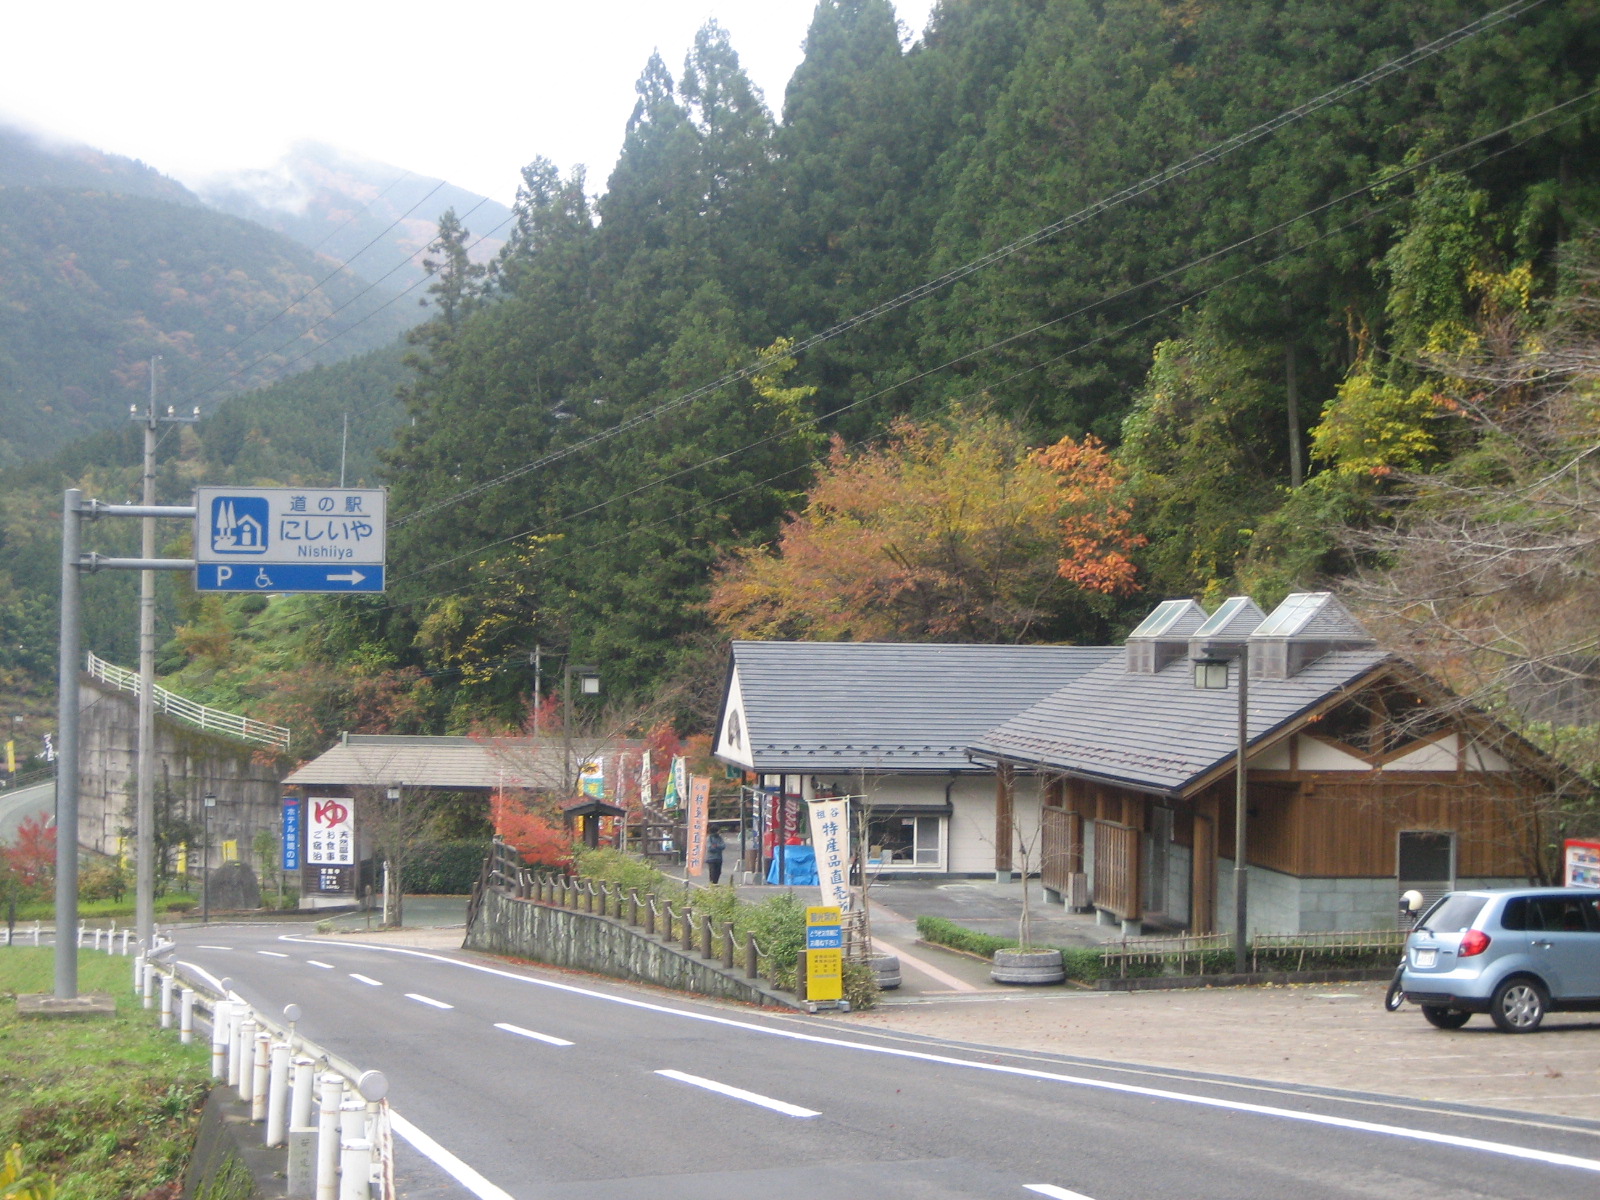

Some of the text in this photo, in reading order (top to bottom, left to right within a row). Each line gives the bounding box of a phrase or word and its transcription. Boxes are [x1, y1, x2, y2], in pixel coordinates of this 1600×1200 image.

[290, 496, 362, 513] 道の駅
[280, 520, 372, 541] にしいや
[298, 545, 353, 560] Nishiiya
[217, 566, 232, 587] P
[314, 799, 348, 829] ゆ
[313, 830, 323, 861] ご宿泊
[326, 830, 336, 861] お食事
